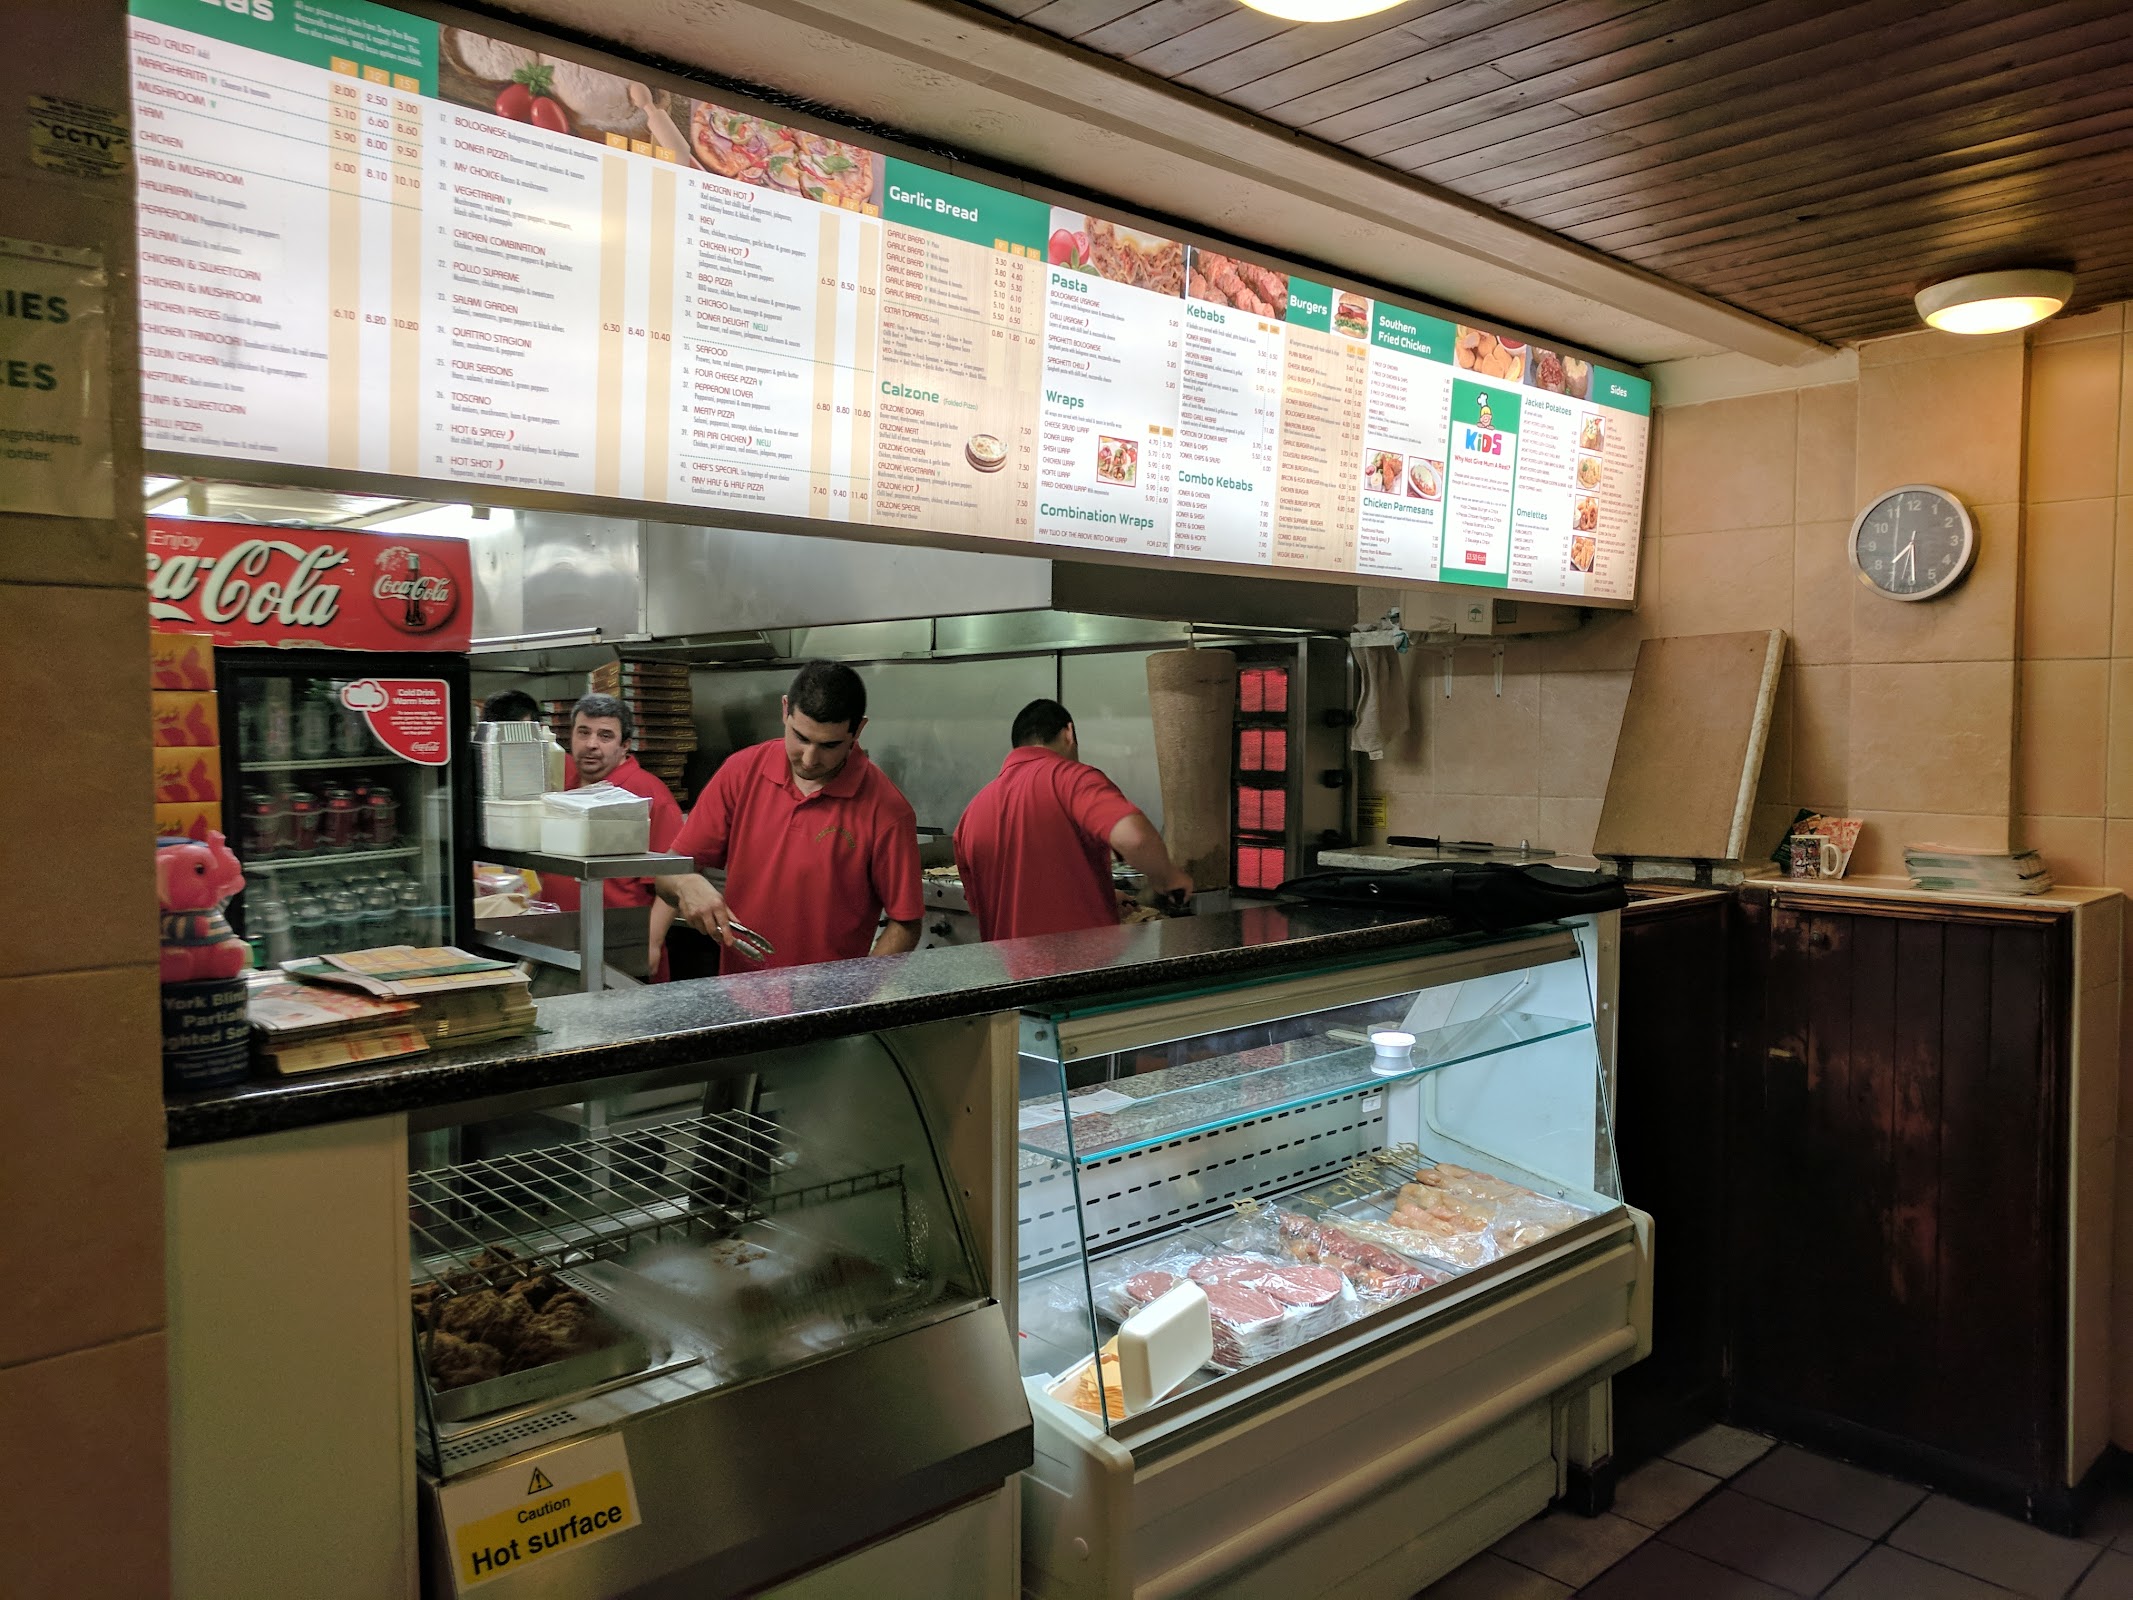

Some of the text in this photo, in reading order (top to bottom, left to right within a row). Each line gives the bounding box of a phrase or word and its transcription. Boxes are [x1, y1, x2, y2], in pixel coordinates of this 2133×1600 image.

[164, 39, 196, 55] CRUST
[138, 56, 208, 82] MARGHERITA
[138, 81, 206, 106] MUSHROOM
[334, 84, 417, 115] 2.00 2.50 3.00
[139, 106, 164, 119] HAM
[335, 106, 417, 137] 5.10 6.60 8.60
[455, 116, 507, 138] BOLOGNESE
[50, 125, 110, 150] CCTV
[140, 131, 184, 148] CHICKEN
[335, 129, 417, 159] 5.90 8.00 9.50
[455, 139, 484, 156] DONER
[487, 146, 509, 161] PIZZA
[167, 161, 175, 170] &
[179, 163, 244, 185] MUSHROOM
[335, 159, 420, 189] 6.00 8.10 10.10
[454, 161, 467, 172] MY
[469, 165, 500, 181] CHOICE
[454, 184, 505, 204] VEGETARIAN
[702, 182, 747, 200] MEXICAN HOT
[889, 185, 978, 222] Garlic Bread
[700, 215, 714, 226] KIEV
[454, 229, 546, 255] CHICKEN COMBINATION
[700, 239, 727, 254] CHICKEN
[729, 246, 742, 256] HOT
[454, 262, 520, 282] POLLO SUPREME
[698, 273, 732, 287] BBQ PIZZA
[821, 277, 875, 296] 6.50 8.50 10.50
[1052, 273, 1088, 293] Pasta
[453, 295, 518, 314] SALAMI GARDEN
[697, 297, 728, 310] CHICAGO
[1290, 295, 1327, 315] Burgers
[334, 308, 419, 331] 6.10 8.20 10.20
[697, 311, 720, 324] DONER
[722, 316, 749, 328] DELIGHT
[753, 321, 768, 332] NEW
[1187, 303, 1225, 324] Kebabs
[603, 323, 670, 341] 6.30 8.40 10.40
[1379, 316, 1416, 335] Southern
[452, 327, 492, 341] QUATTRO
[494, 334, 532, 349] STAGIONI
[1378, 331, 1431, 354] Fried Chicken
[696, 345, 728, 357] SEAFOOD
[452, 360, 513, 377] FOUR SEASONS
[695, 367, 713, 378] FOUR
[715, 371, 738, 383] CHEESE
[740, 375, 757, 385] PIZZA
[452, 392, 491, 405] TOSCANO
[695, 382, 753, 398] PEPPERONI LOVER
[881, 380, 939, 403] Calzone
[1610, 384, 1628, 397] Sides
[1046, 390, 1084, 409] Wraps
[1525, 397, 1572, 416] Jacket Potatoes
[694, 406, 735, 419] MEATY PIZZA
[816, 402, 871, 417] 6.80 8.80 10.80
[451, 425, 506, 439] HOT & SPICEY
[693, 429, 771, 447] PIRI PIRI CHICKEN NEW
[451, 457, 492, 469] HOT SHOT
[1455, 455, 1463, 464] Why
[715, 465, 739, 476] SPECIAL
[692, 476, 764, 492] ANY HALF & HALF PIZZA
[1179, 470, 1253, 492] Combo Kebabs
[813, 487, 867, 501] 7.40 9.40 11.40
[1363, 497, 1434, 516] Chicken Parmesans
[1517, 508, 1547, 520] Omelettes
[1908, 501, 1921, 511] 12
[1932, 504, 1938, 514] 1
[1040, 503, 1153, 530] Combination Wraps
[1945, 517, 1953, 527] 2
[1874, 523, 1888, 533] 10
[151, 530, 204, 551] Enjoy
[1869, 542, 1877, 551] 9
[1950, 535, 1959, 546] 3
[1875, 560, 1882, 570] 8
[1942, 554, 1951, 564] 4
[1928, 569, 1936, 579] 5
[518, 1498, 570, 1523] Caution
[472, 1505, 622, 1575] Hot surface
